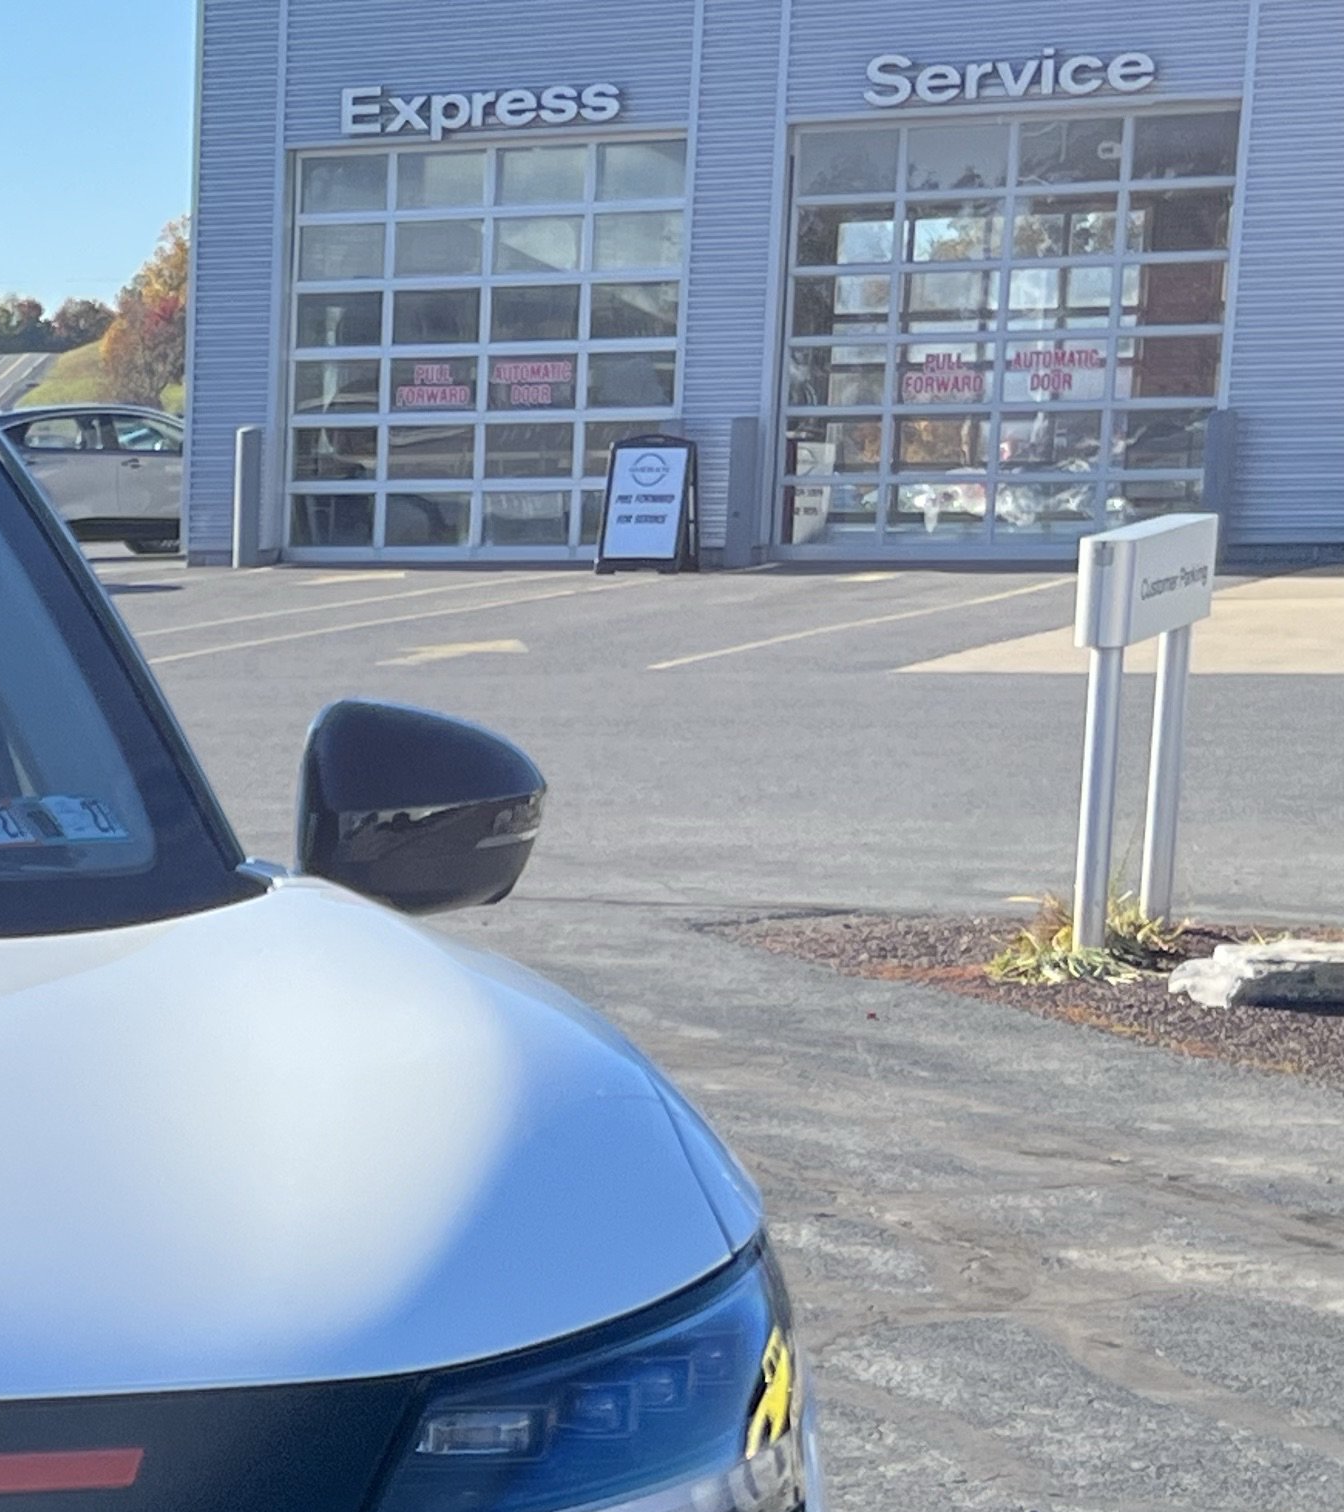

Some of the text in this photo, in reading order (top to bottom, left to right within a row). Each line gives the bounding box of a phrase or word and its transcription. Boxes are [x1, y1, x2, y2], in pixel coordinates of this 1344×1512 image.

[863, 47, 1156, 107] Service
[340, 82, 621, 141] Express
[923, 352, 964, 374] PULL
[1010, 349, 1100, 370] AUTOMATIC
[415, 363, 453, 385] PULL
[491, 361, 572, 384] AUTOMATIC
[903, 372, 984, 395] FORWARD
[1029, 370, 1073, 392] DOOR
[396, 385, 471, 407] FORWARD
